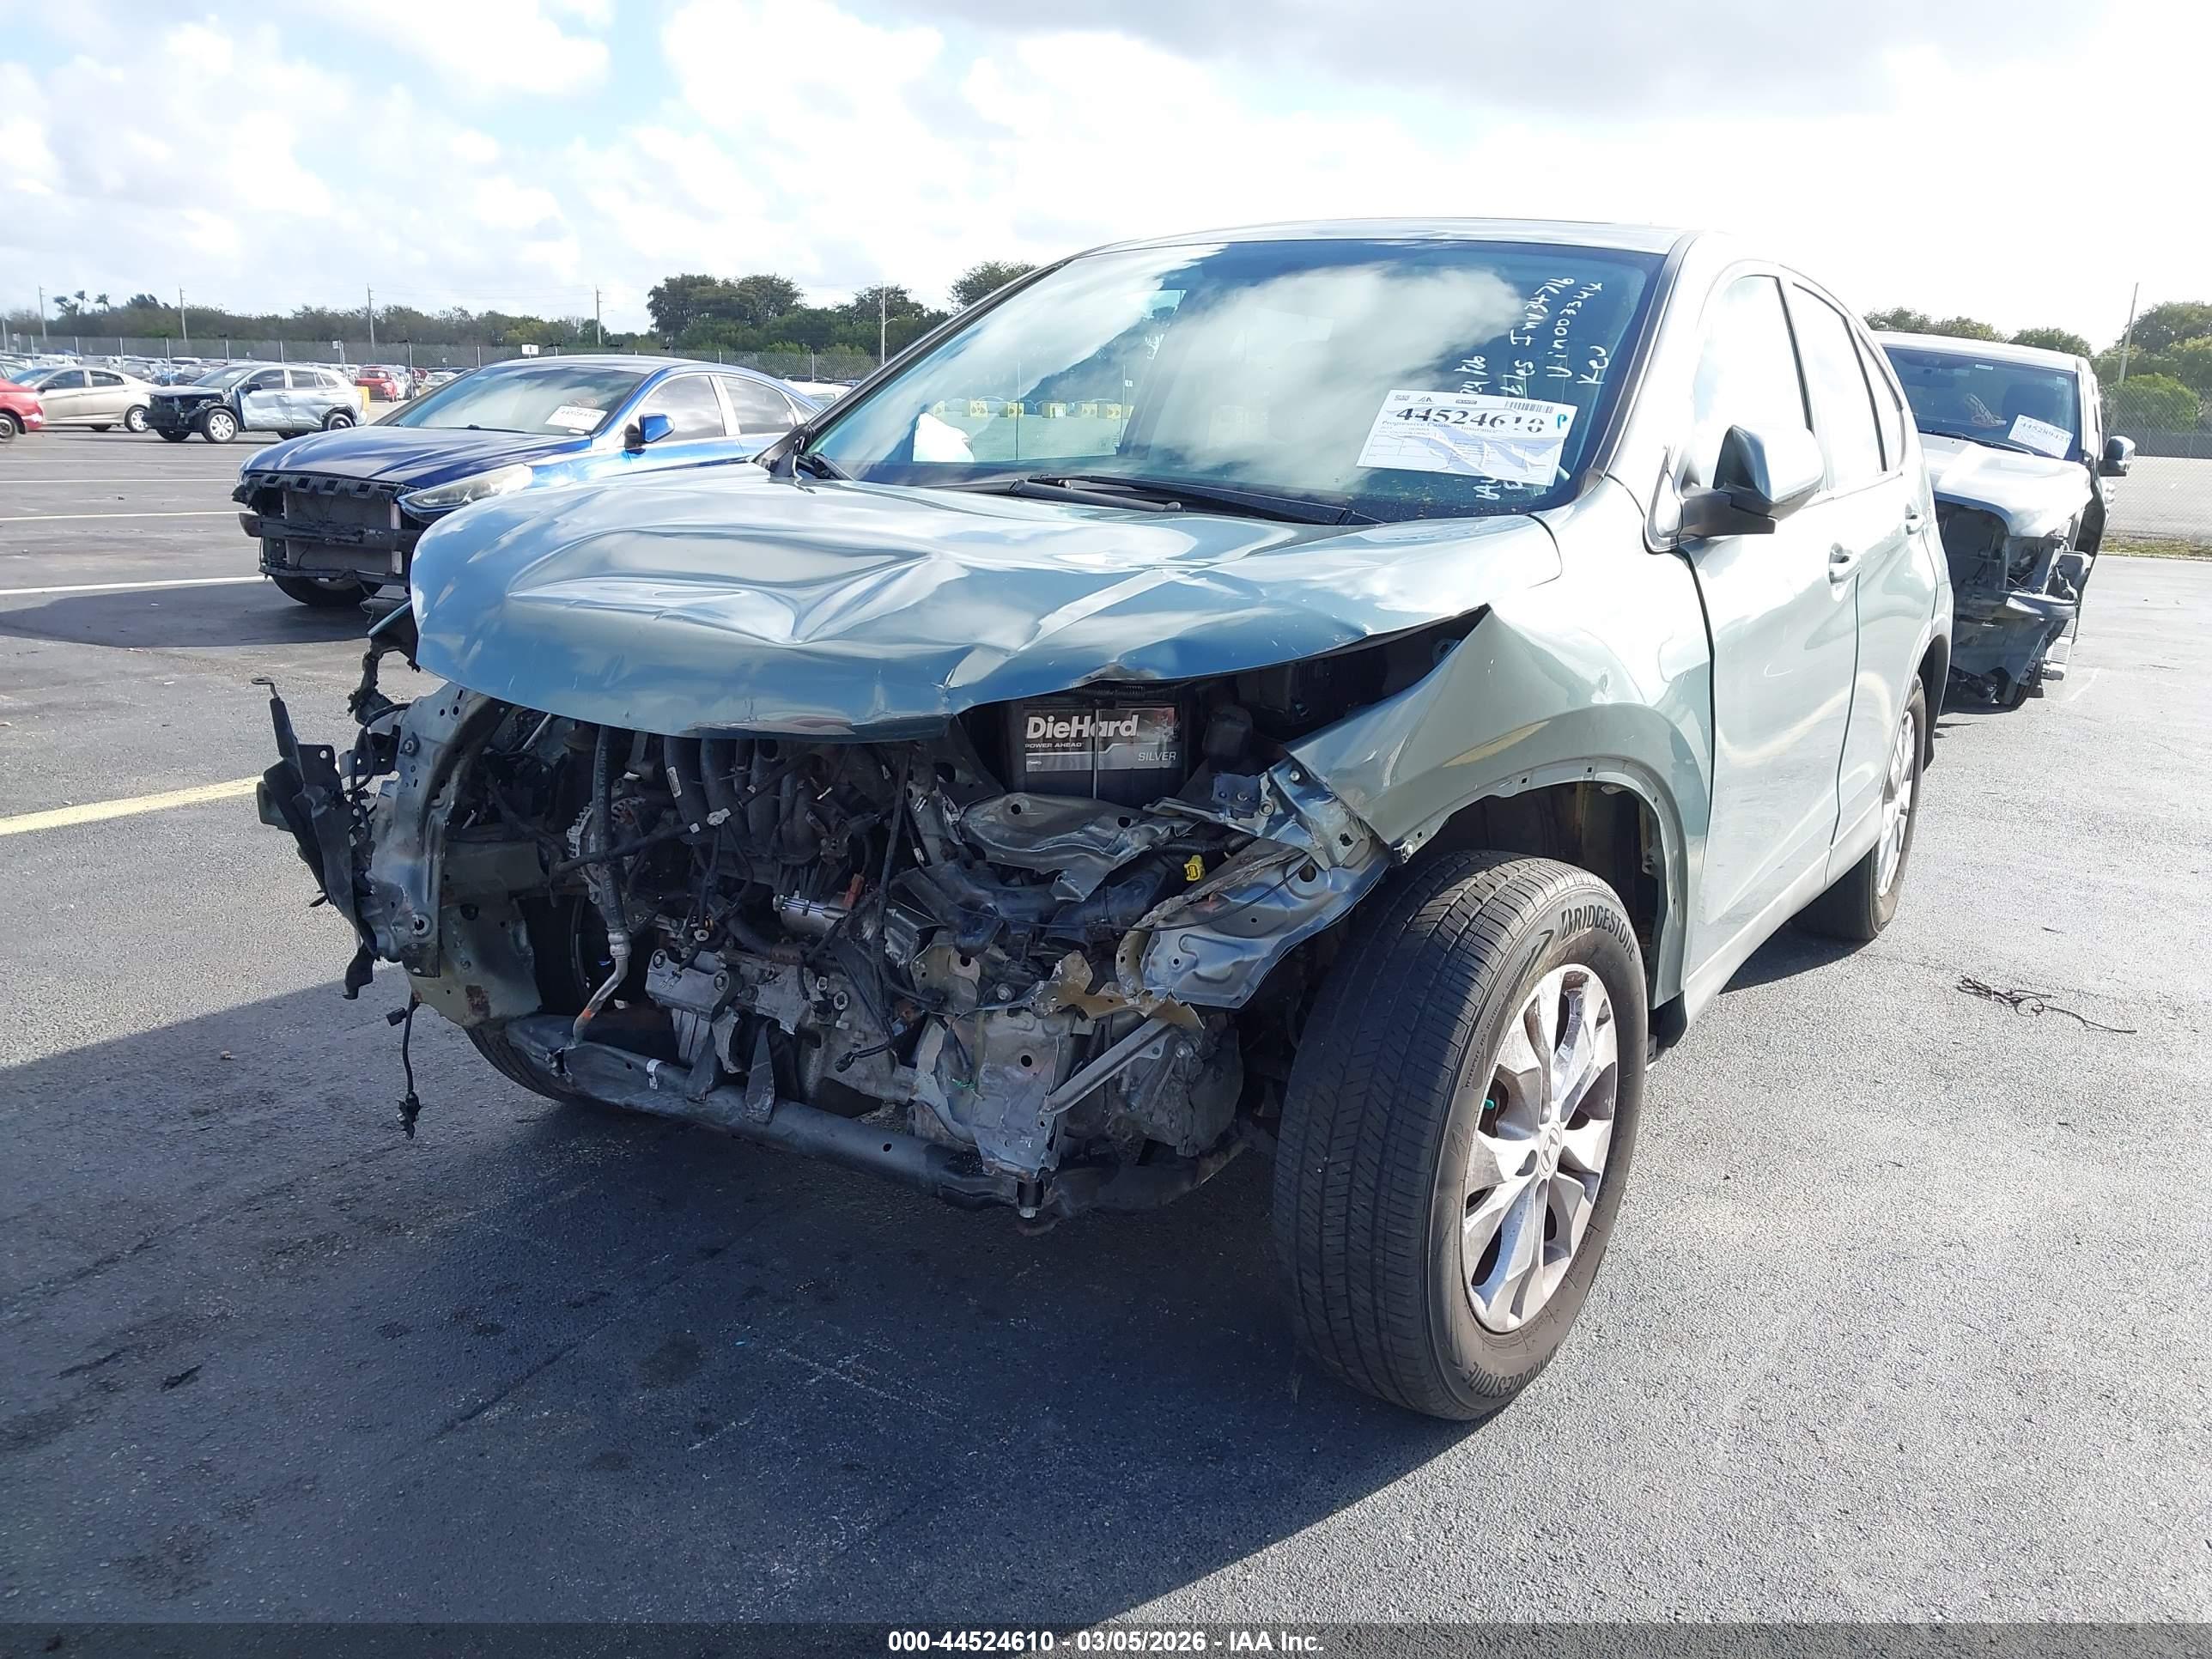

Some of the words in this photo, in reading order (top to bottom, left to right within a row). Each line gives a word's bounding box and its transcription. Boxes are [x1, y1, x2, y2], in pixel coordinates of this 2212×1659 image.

[1396, 407, 1545, 434] 44524610
[1026, 714, 1139, 739] DieHard
[1138, 751, 1177, 762] SILVER
[1560, 905, 1636, 962] BRIDGESTONE
